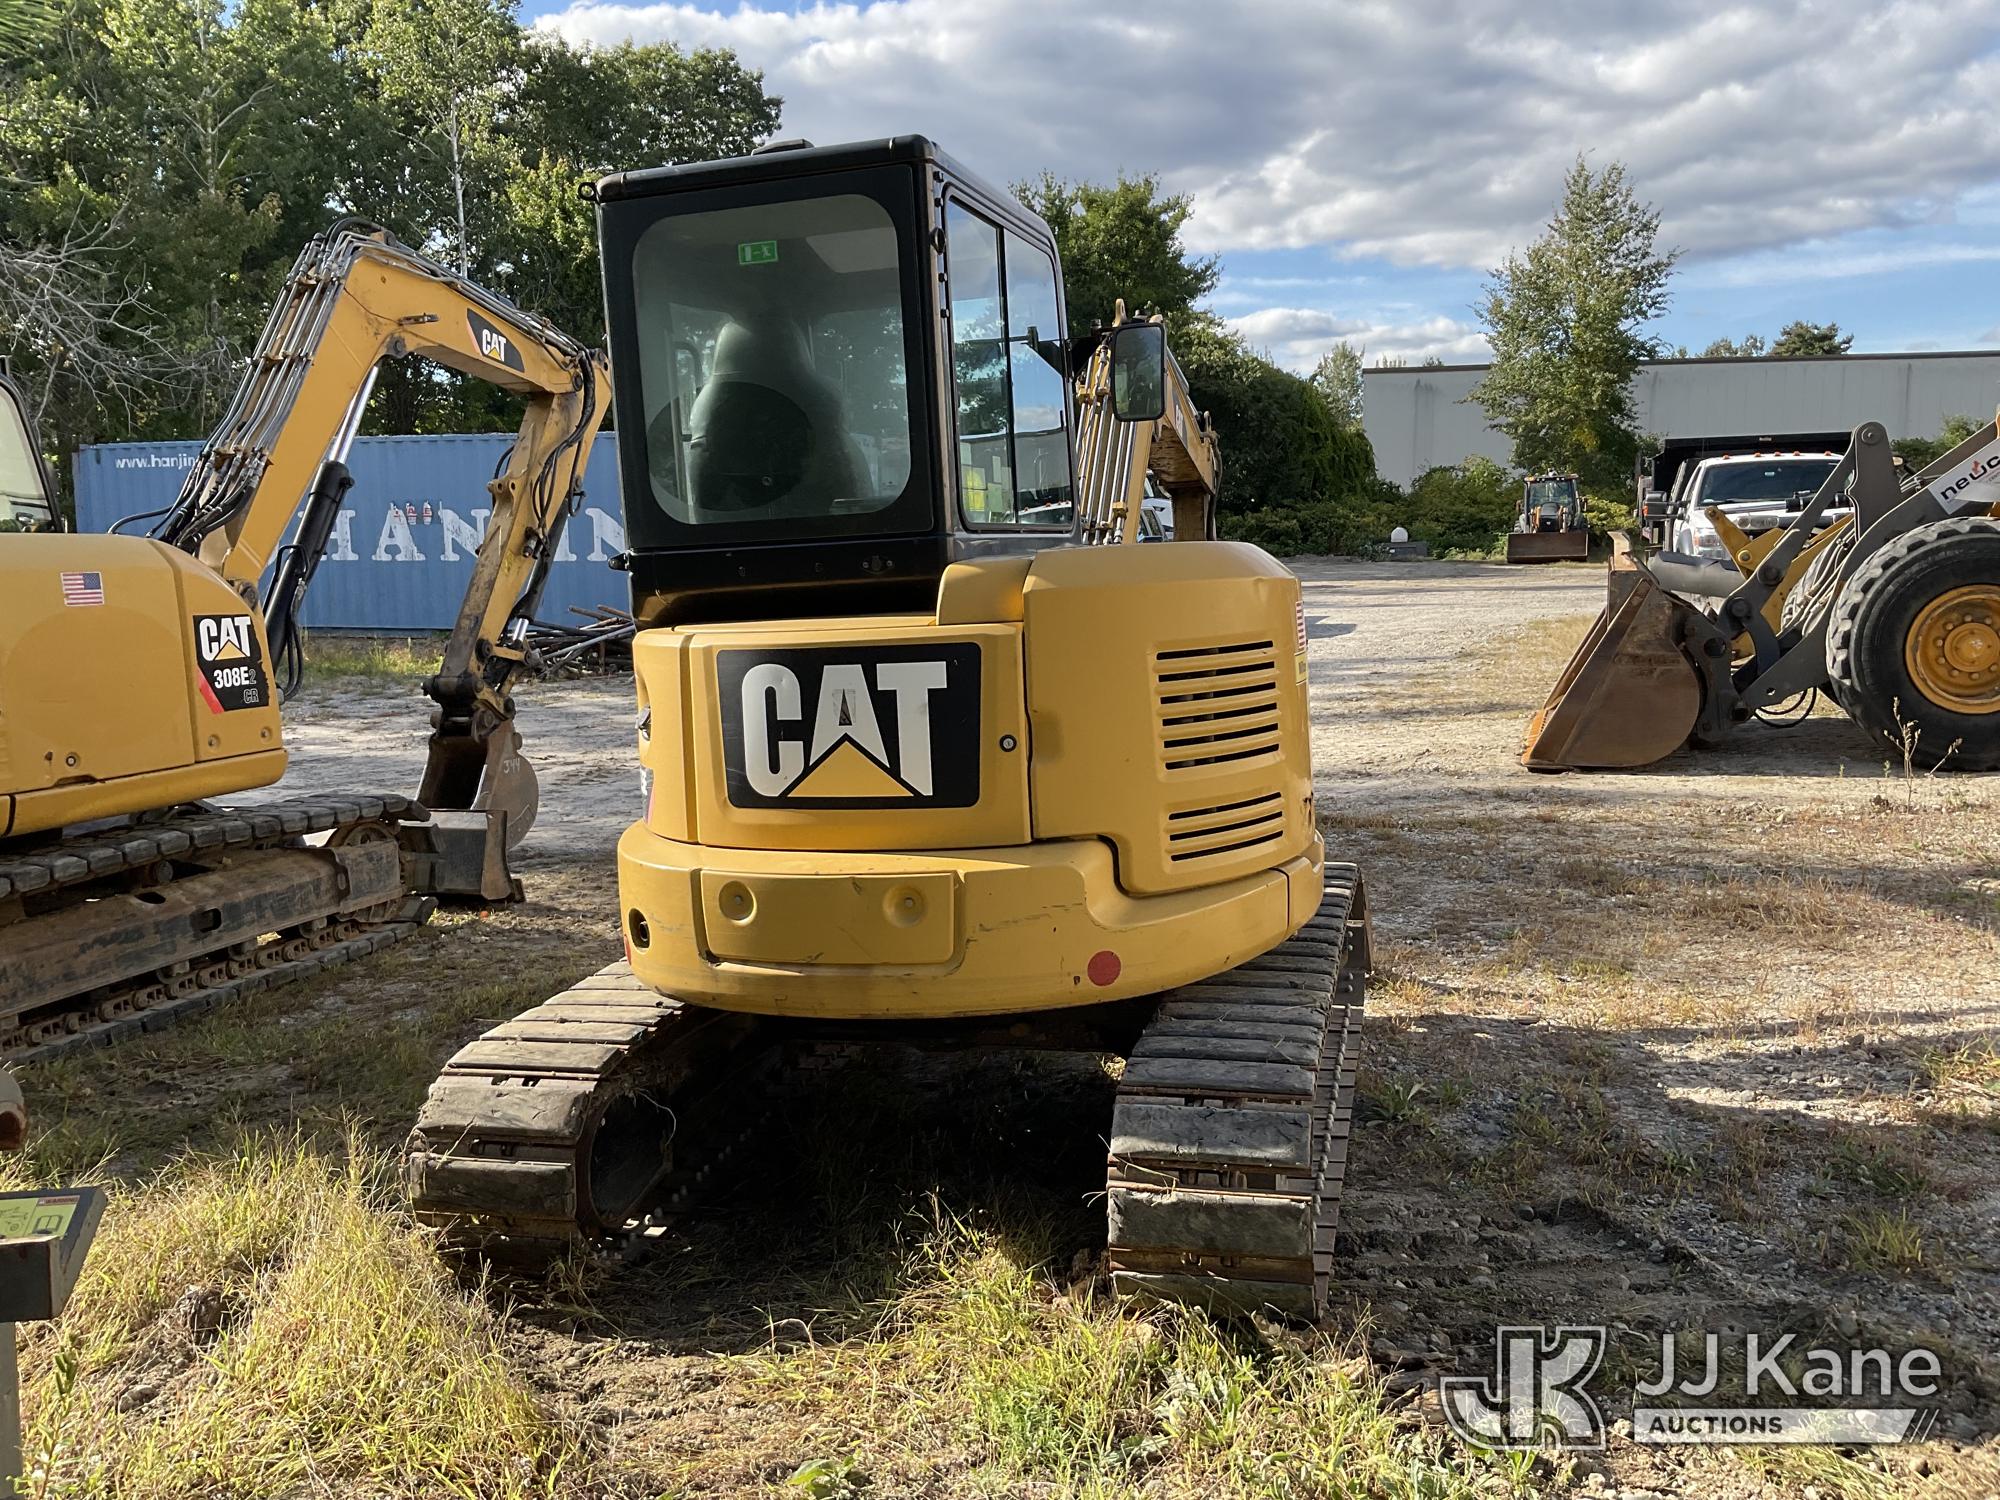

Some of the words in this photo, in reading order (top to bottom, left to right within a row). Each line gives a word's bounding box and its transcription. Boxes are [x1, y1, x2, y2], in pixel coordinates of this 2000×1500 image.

[482, 328, 507, 362] CAT
[297, 508, 625, 562] HANIN
[199, 616, 251, 661] CAT
[244, 688, 259, 704] CR
[741, 660, 947, 797] CAT
